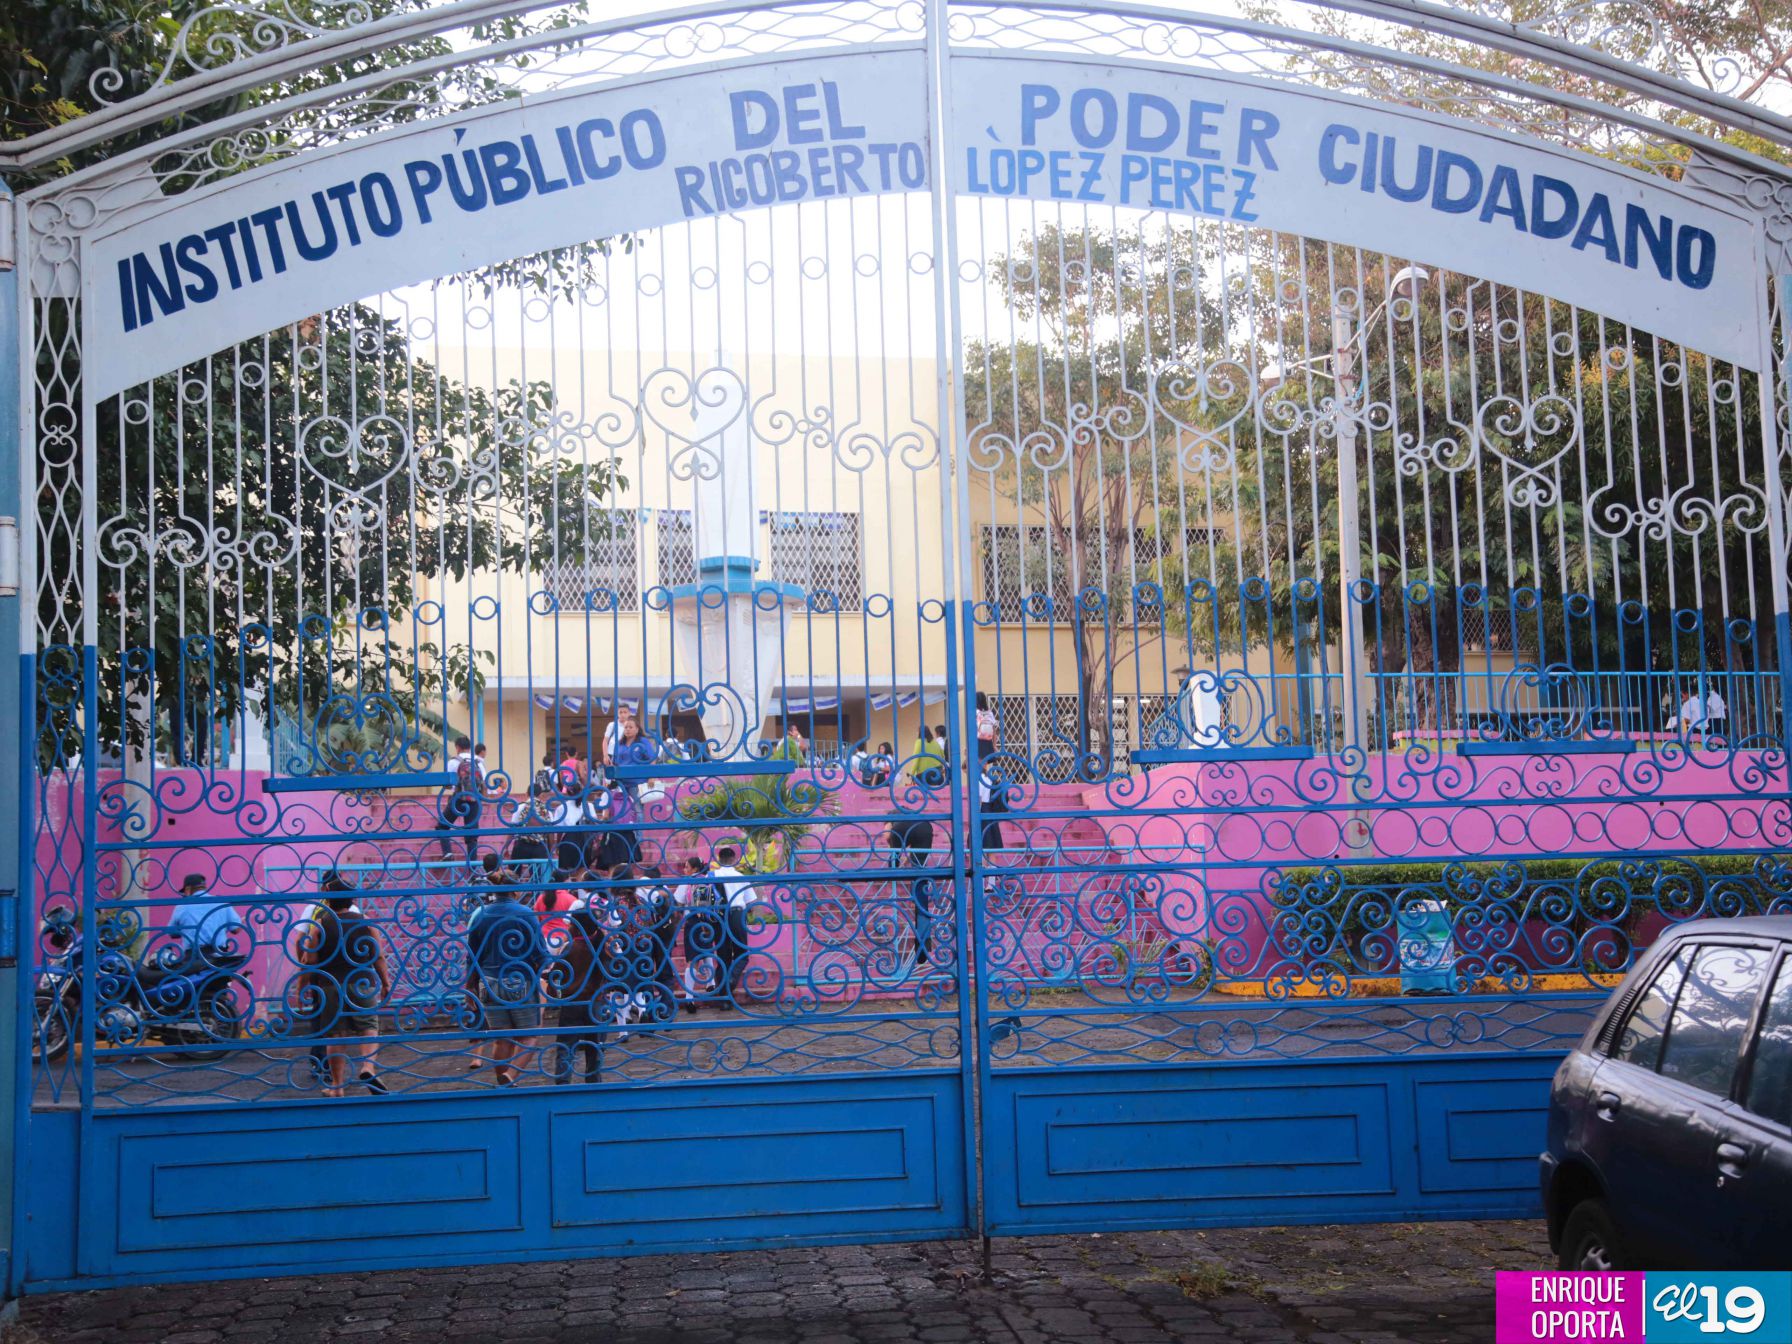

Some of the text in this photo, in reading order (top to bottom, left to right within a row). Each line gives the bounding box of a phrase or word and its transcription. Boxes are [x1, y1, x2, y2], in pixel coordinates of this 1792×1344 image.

[117, 80, 1717, 333] INSTITUTO PÚBLICO DEL PODER CIUDADANO
[674, 141, 926, 218] RIGOBERTO
[1119, 153, 1261, 223] PEREZ
